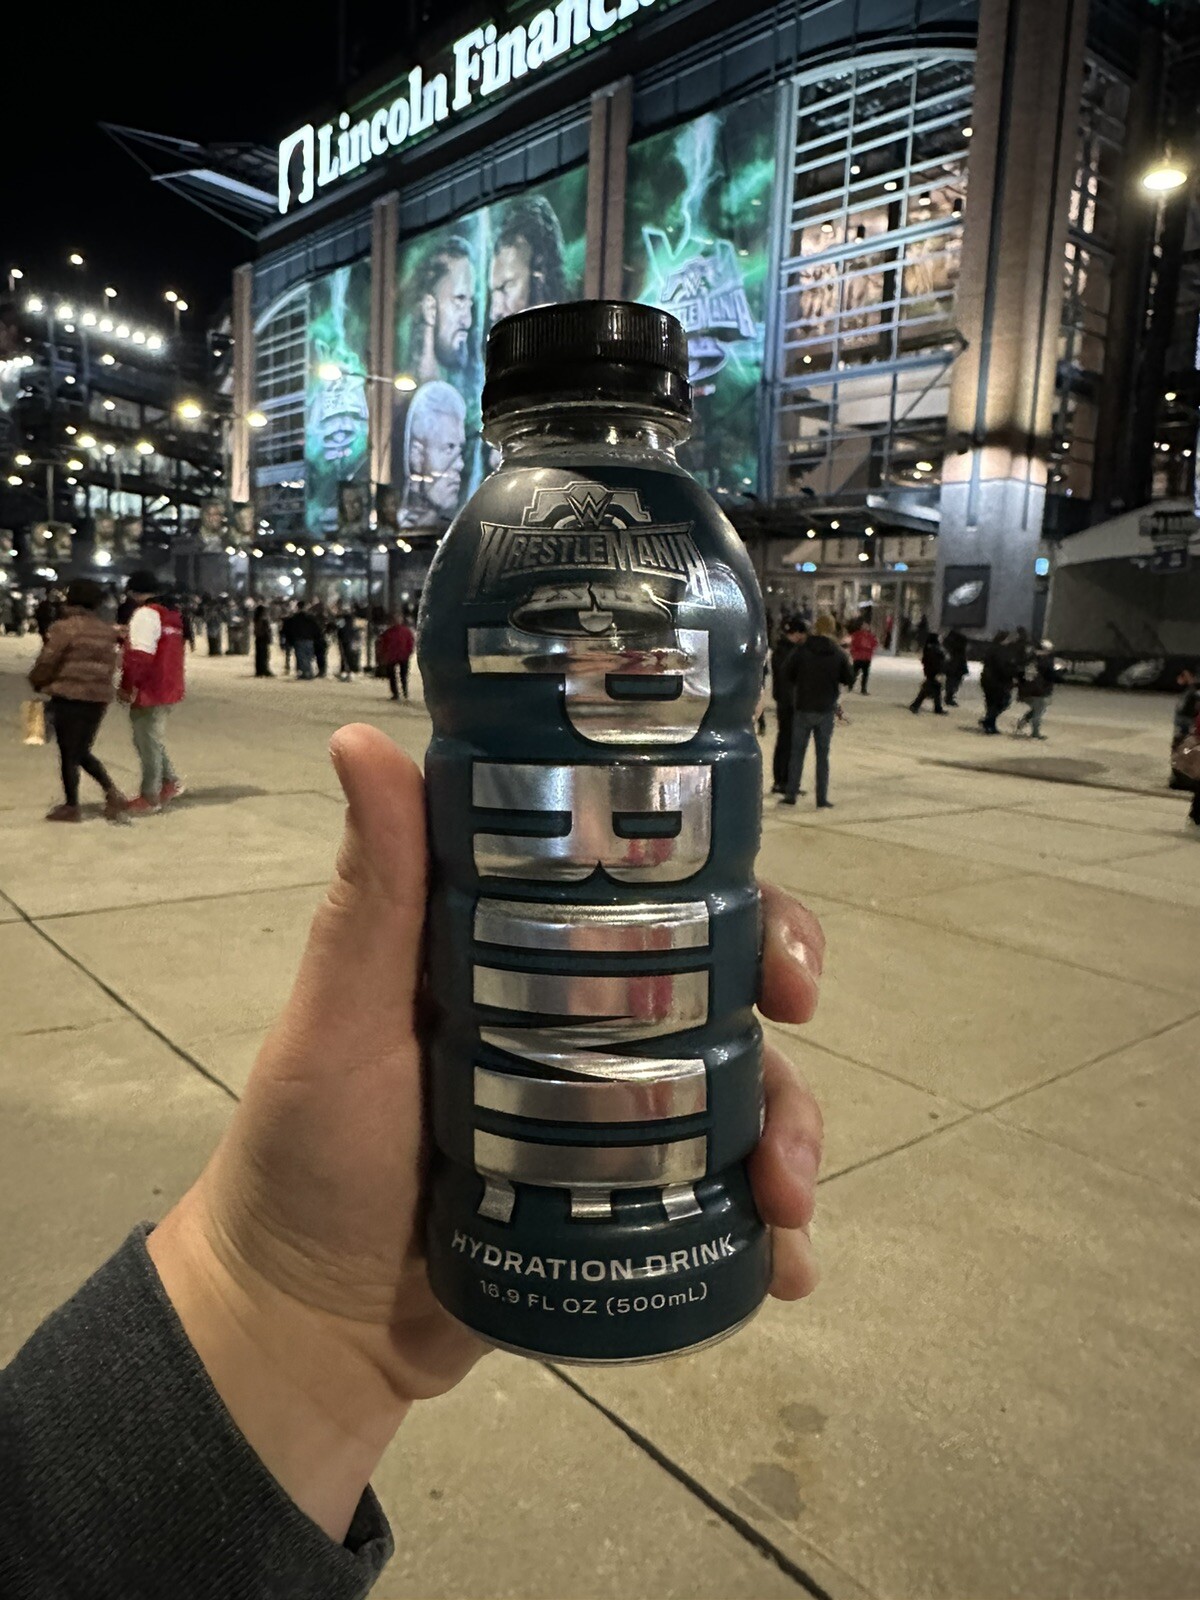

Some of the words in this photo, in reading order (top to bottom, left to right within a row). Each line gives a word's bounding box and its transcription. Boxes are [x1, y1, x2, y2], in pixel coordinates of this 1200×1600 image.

[317, 65, 448, 186] Lincoln
[451, 0, 656, 111] Financ
[468, 628, 713, 1223] PRIME
[451, 1229, 634, 1281] HYDRATION
[646, 1232, 737, 1276] DRINK
[527, 1293, 555, 1311] FL
[562, 1297, 598, 1315] OZ
[606, 1281, 708, 1316] (500mL)
